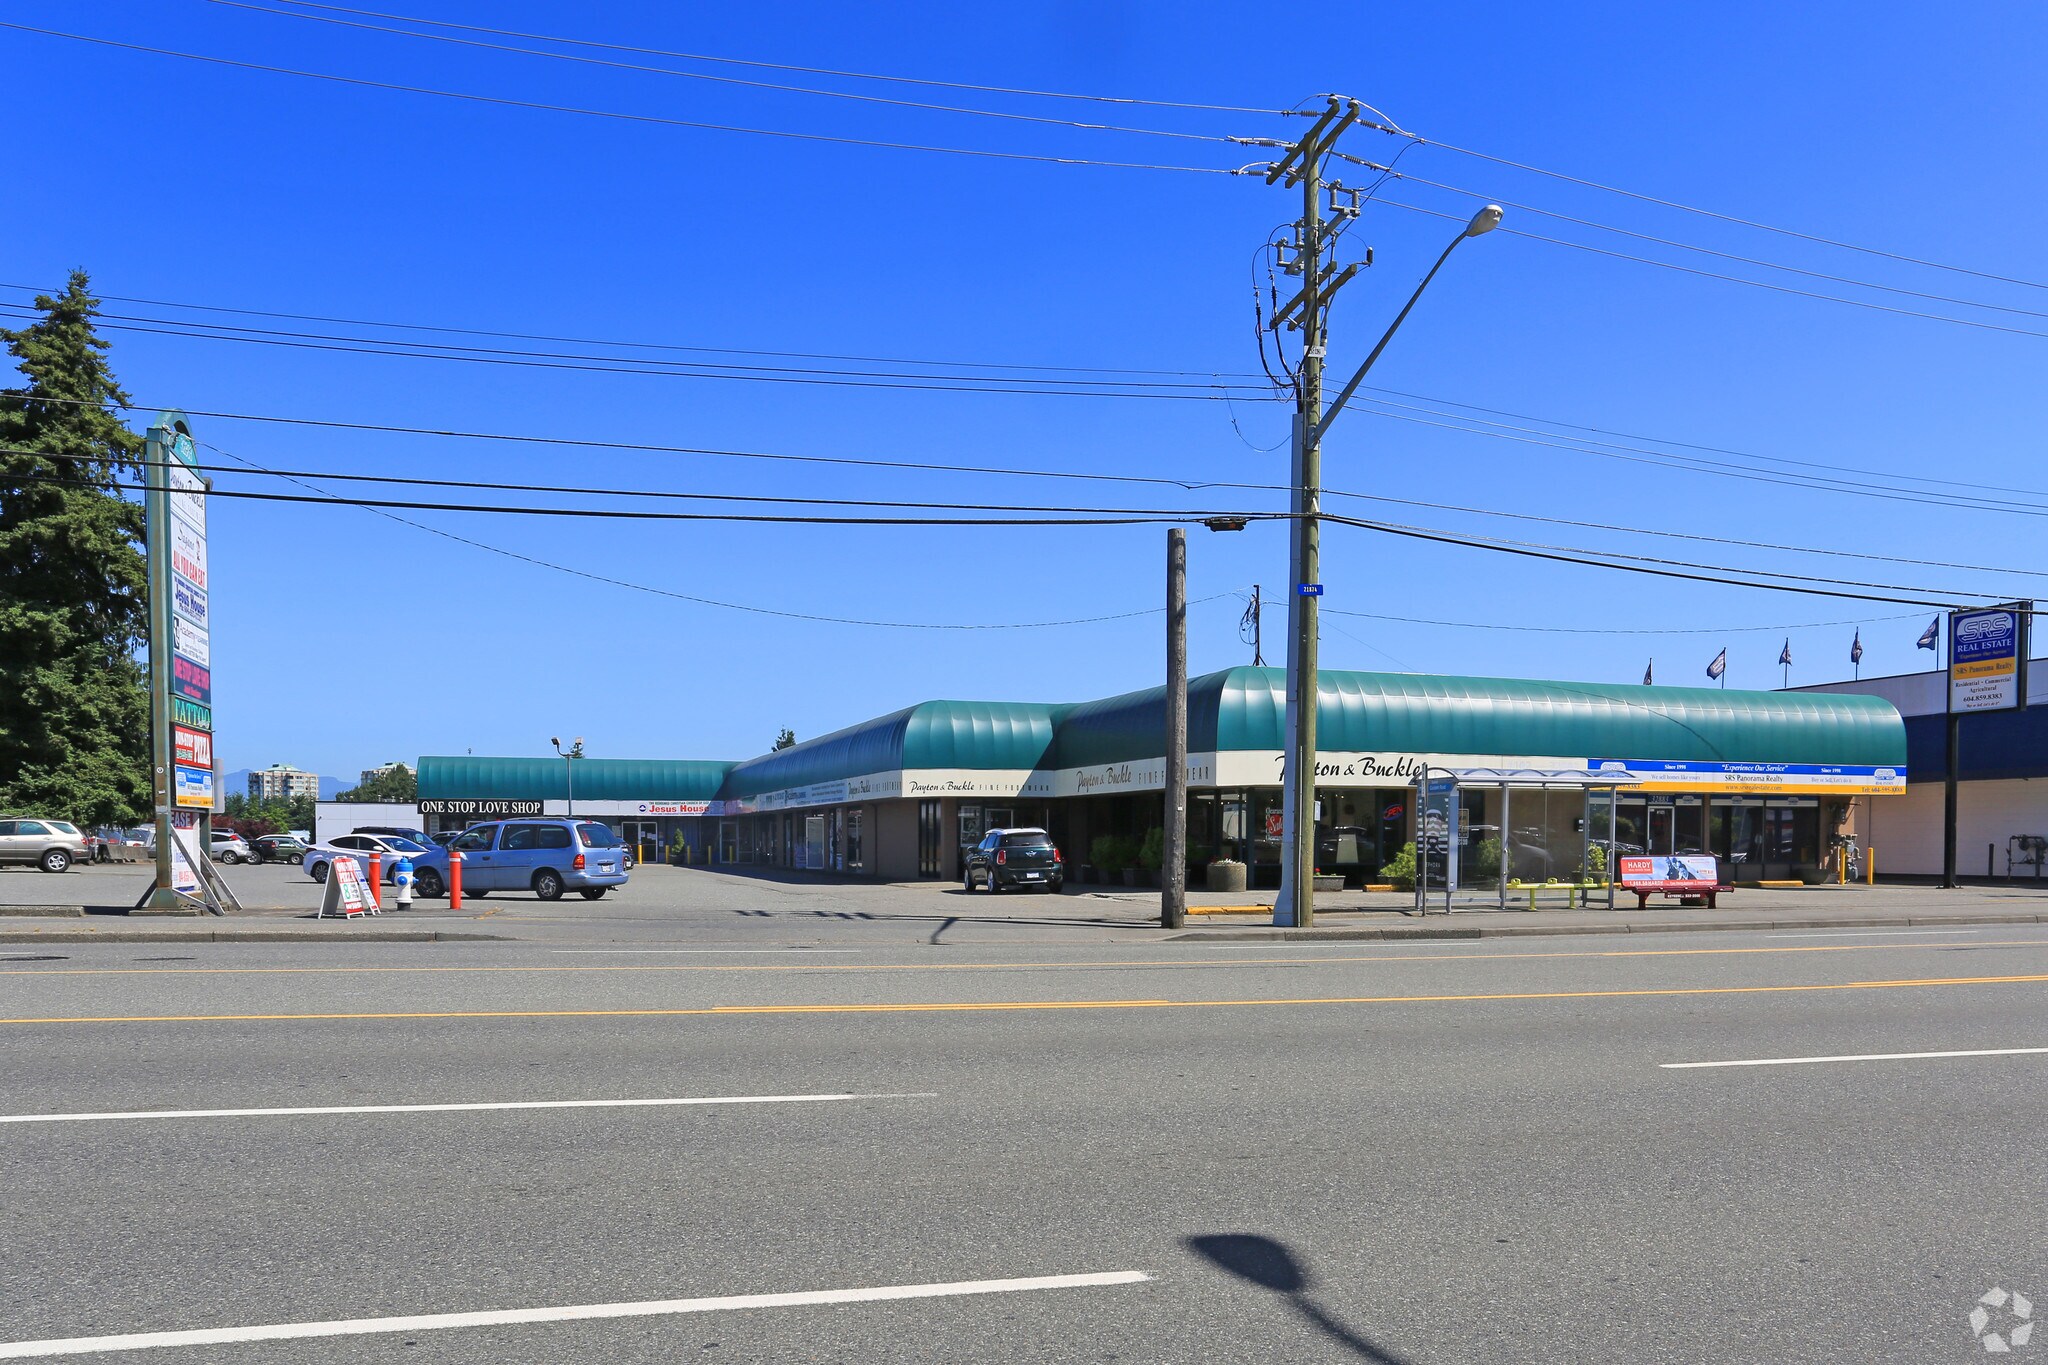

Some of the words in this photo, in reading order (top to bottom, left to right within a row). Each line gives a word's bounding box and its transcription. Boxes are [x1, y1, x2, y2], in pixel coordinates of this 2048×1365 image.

[173, 550, 181, 571] ALL
[181, 555, 189, 577] YOU
[189, 561, 198, 584] CAN
[198, 568, 206, 588] EAT
[175, 584, 189, 607] Jesus
[1961, 616, 2009, 642] SRS
[1957, 643, 1979, 653] REAL
[1982, 638, 2012, 649] ESTATE
[1970, 685, 1997, 693] Agricultural
[175, 699, 212, 726] TATTOO
[194, 735, 212, 766] PIZZA
[1344, 765, 1355, 776] &
[1357, 756, 1421, 778] Buckle
[909, 781, 939, 793] Payton
[945, 781, 975, 791] Buckle
[1076, 770, 1099, 793] Payton
[1105, 765, 1132, 784] Buckle
[1138, 771, 1158, 784] FINE
[1766, 775, 1783, 783] Realty
[421, 801, 445, 812] ONE
[447, 801, 476, 813] STOP
[479, 801, 509, 813] LOVE
[511, 802, 541, 813] SHOP
[648, 805, 677, 813] Jesus
[680, 805, 710, 813] House
[171, 811, 191, 827] EASE
[1627, 861, 1651, 869] HARDY
